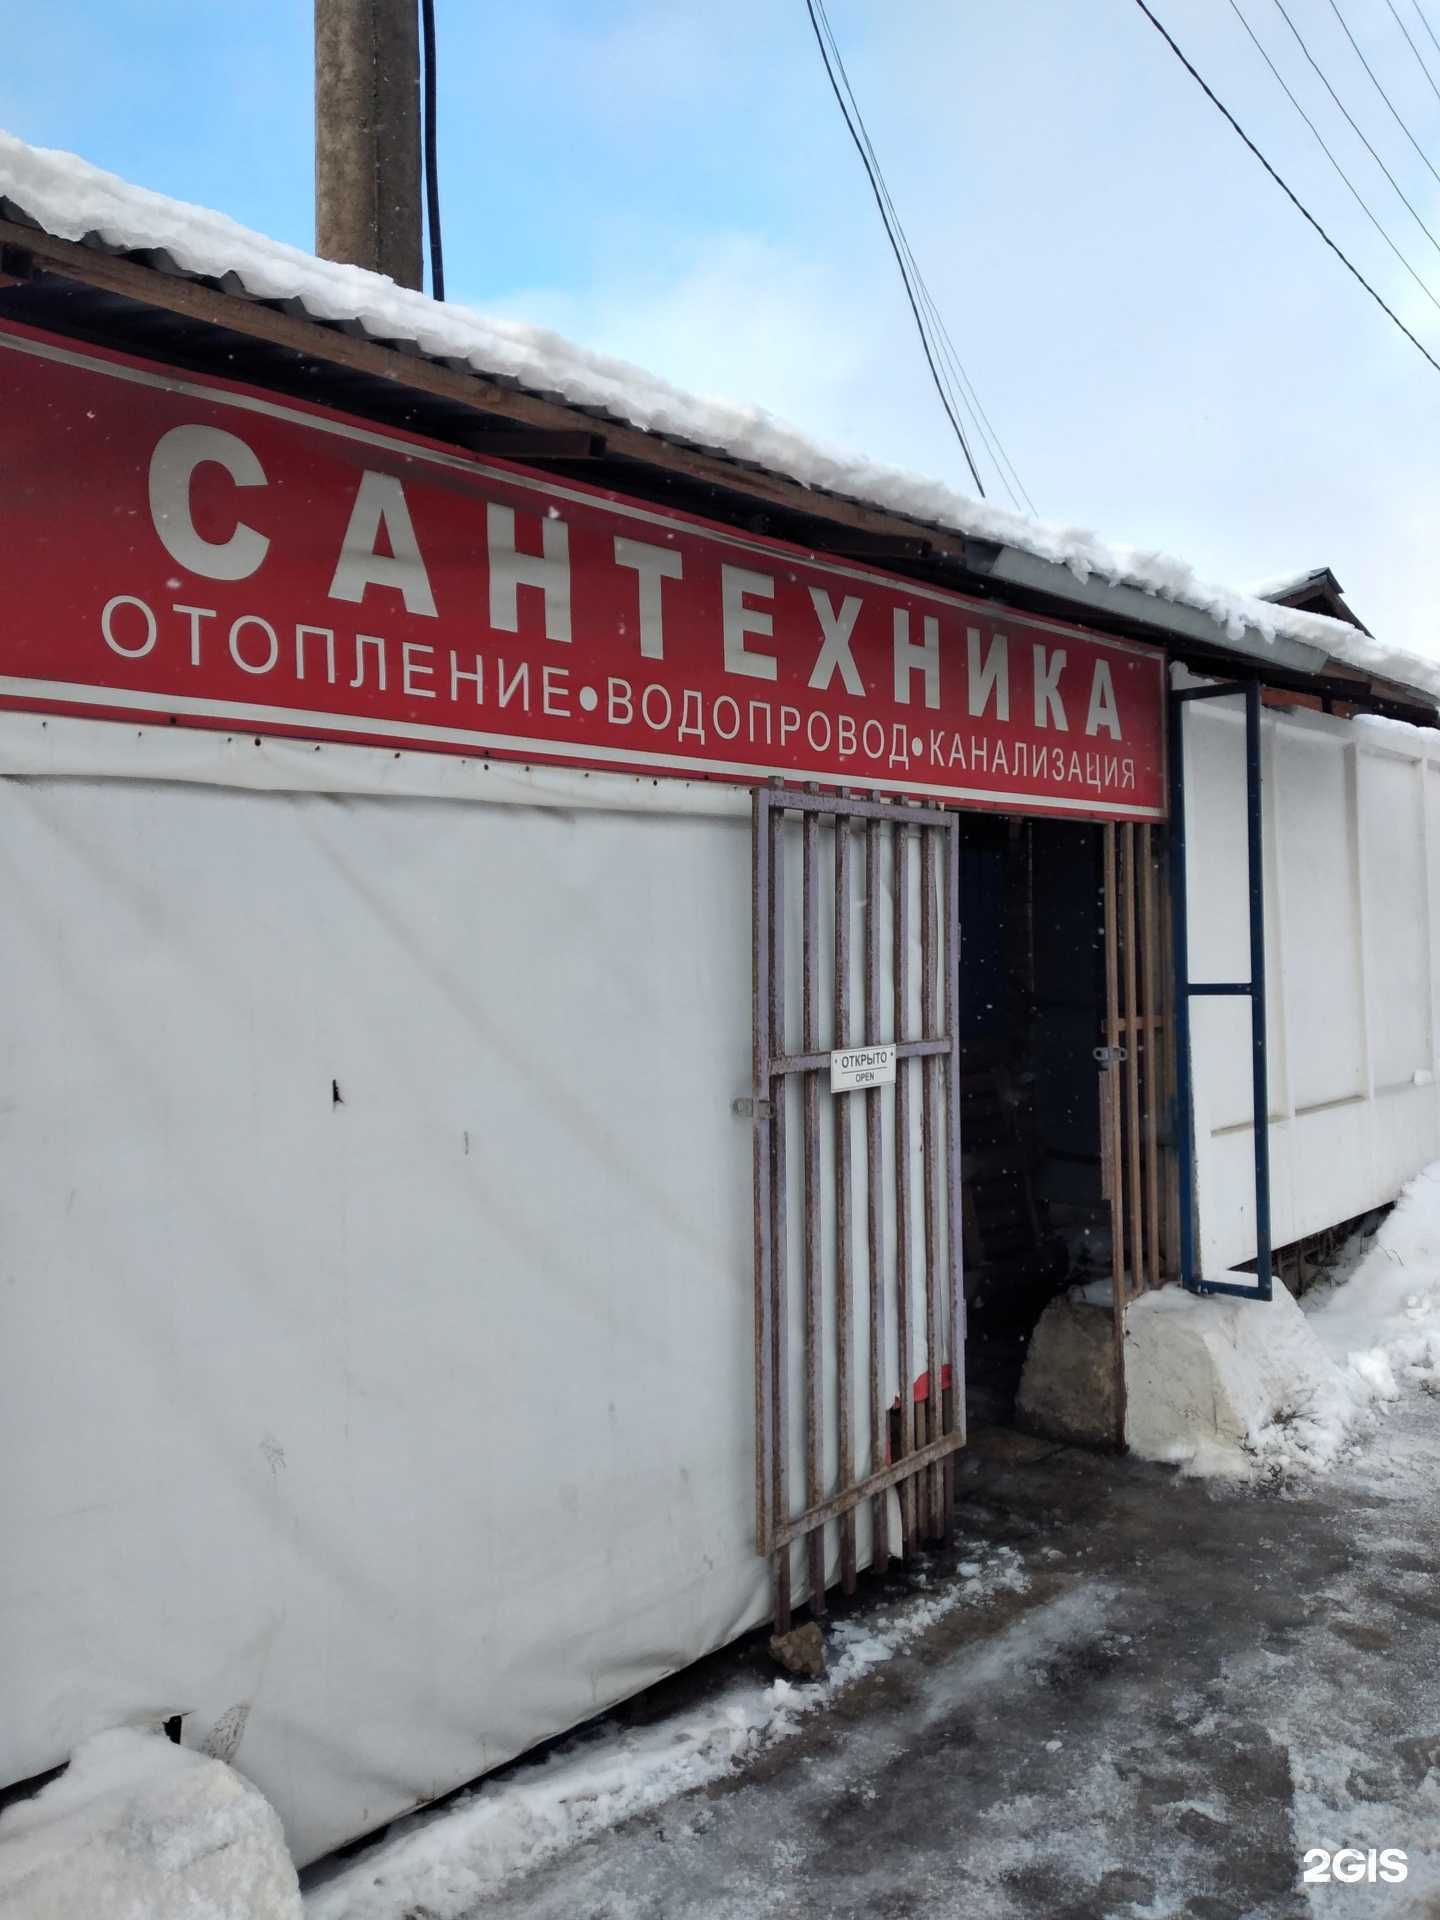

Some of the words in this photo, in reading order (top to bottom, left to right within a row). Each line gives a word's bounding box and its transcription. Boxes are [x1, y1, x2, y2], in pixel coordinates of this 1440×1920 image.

[148, 424, 1122, 741] САНТЕХНИКА
[841, 1052, 888, 1068] ОТКРЫТО
[855, 1072, 875, 1082] OPEN
